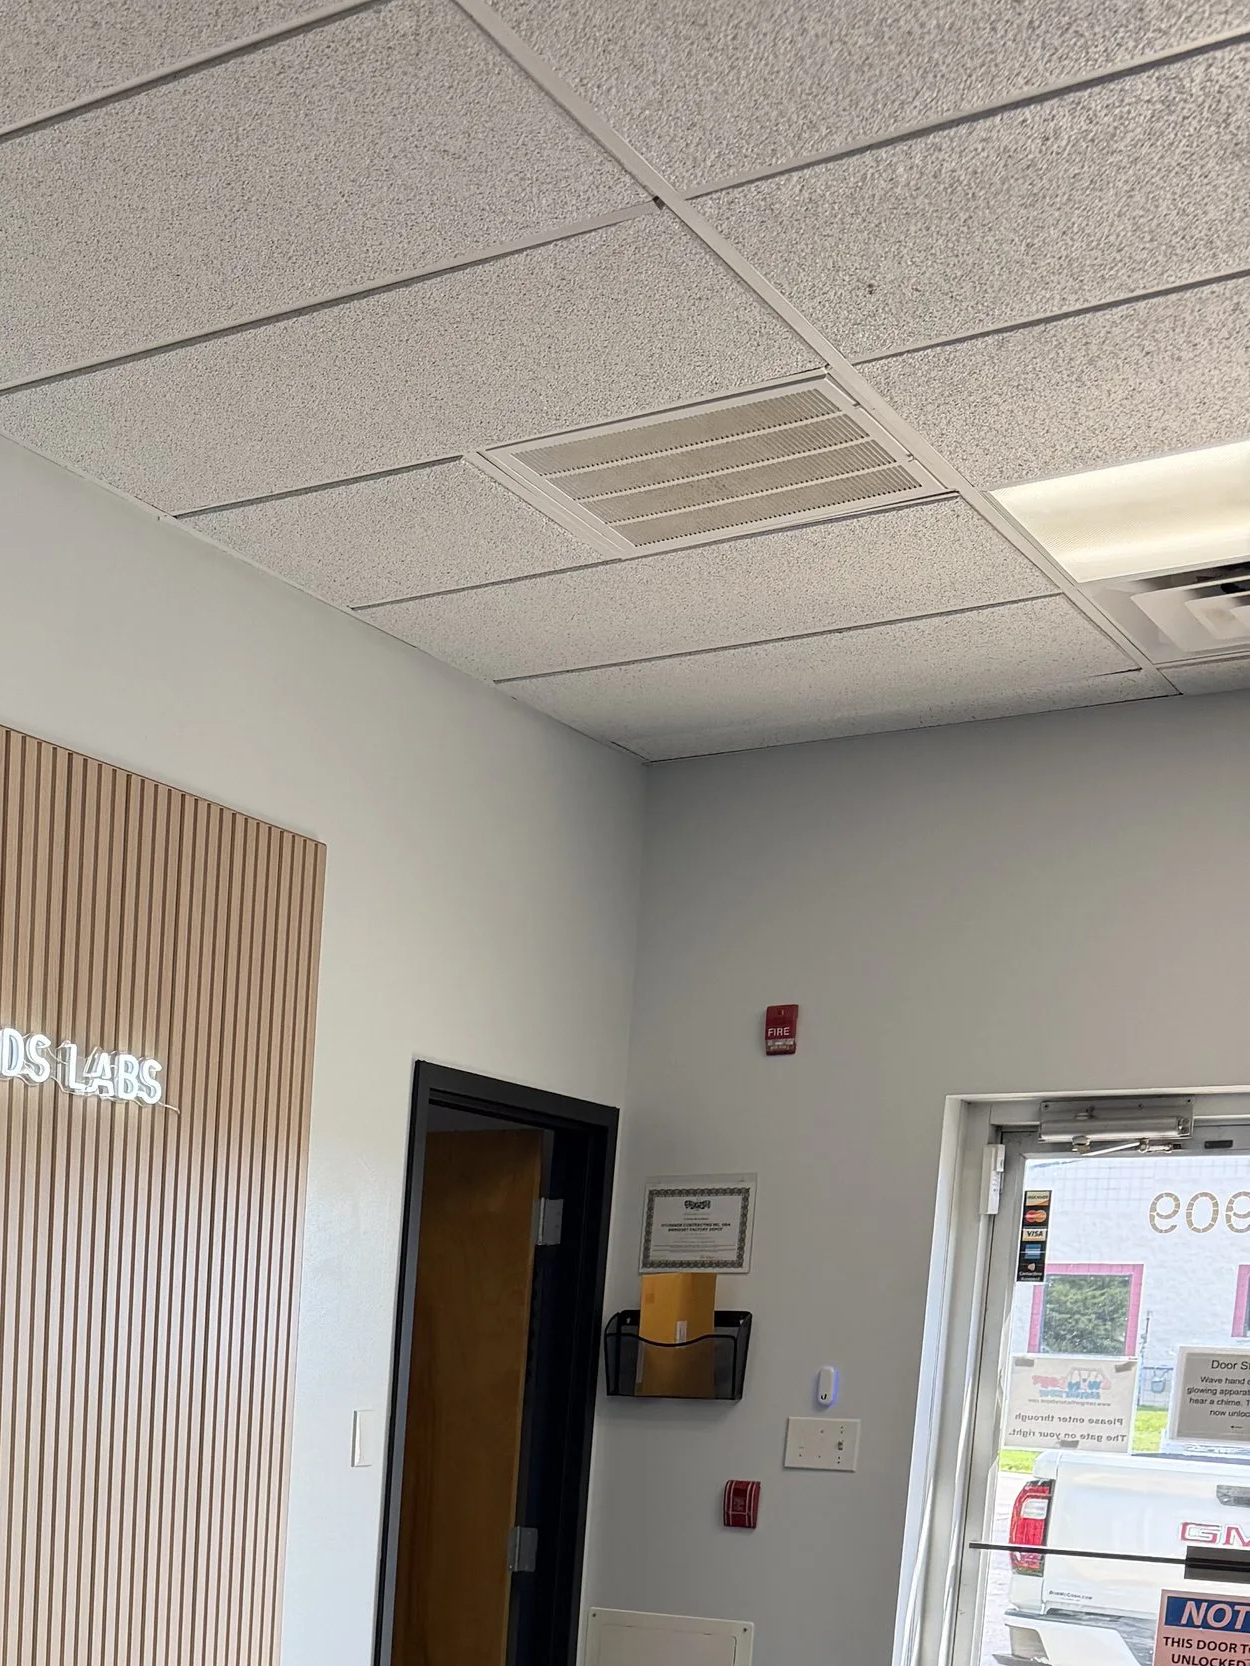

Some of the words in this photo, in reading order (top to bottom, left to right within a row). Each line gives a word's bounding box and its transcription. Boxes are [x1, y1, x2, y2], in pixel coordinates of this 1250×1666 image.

[767, 1027, 790, 1036] FIRE
[59, 1041, 163, 1105] LABS
[1211, 1359, 1238, 1370] Door
[1240, 1360, 1250, 1371] S
[1200, 1376, 1223, 1384] Wave
[1225, 1377, 1245, 1385] hand
[1187, 1386, 1218, 1396] glowing
[1189, 1397, 1207, 1405] hear
[1163, 1636, 1193, 1649] THIS
[1196, 1639, 1238, 1654] DOOR
[1240, 1643, 1250, 1655] T
